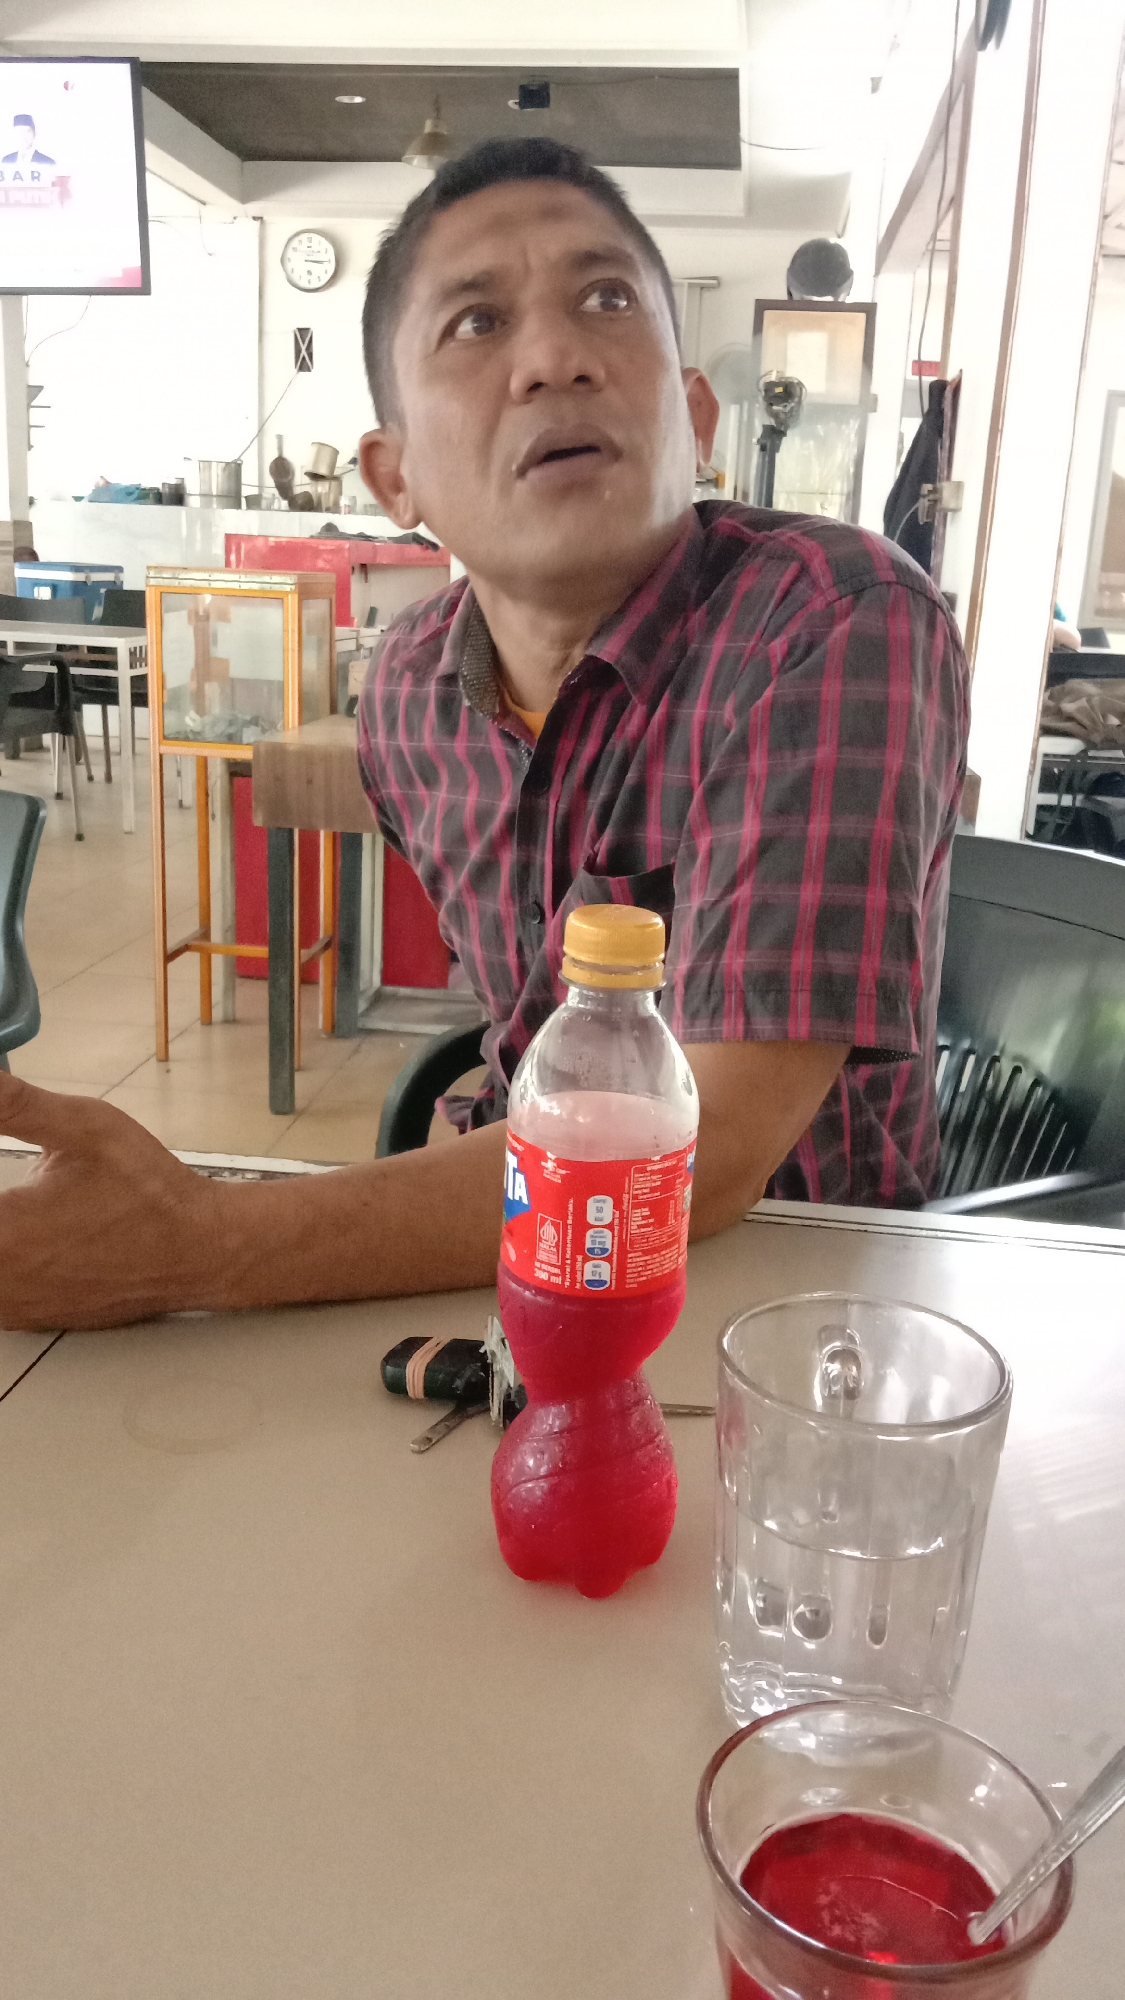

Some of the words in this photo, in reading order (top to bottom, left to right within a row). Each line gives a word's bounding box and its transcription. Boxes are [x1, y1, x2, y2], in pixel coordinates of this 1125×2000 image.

[595, 1206, 604, 1214] 50
[534, 1268, 549, 1281] 390
[550, 1275, 562, 1285] ml
